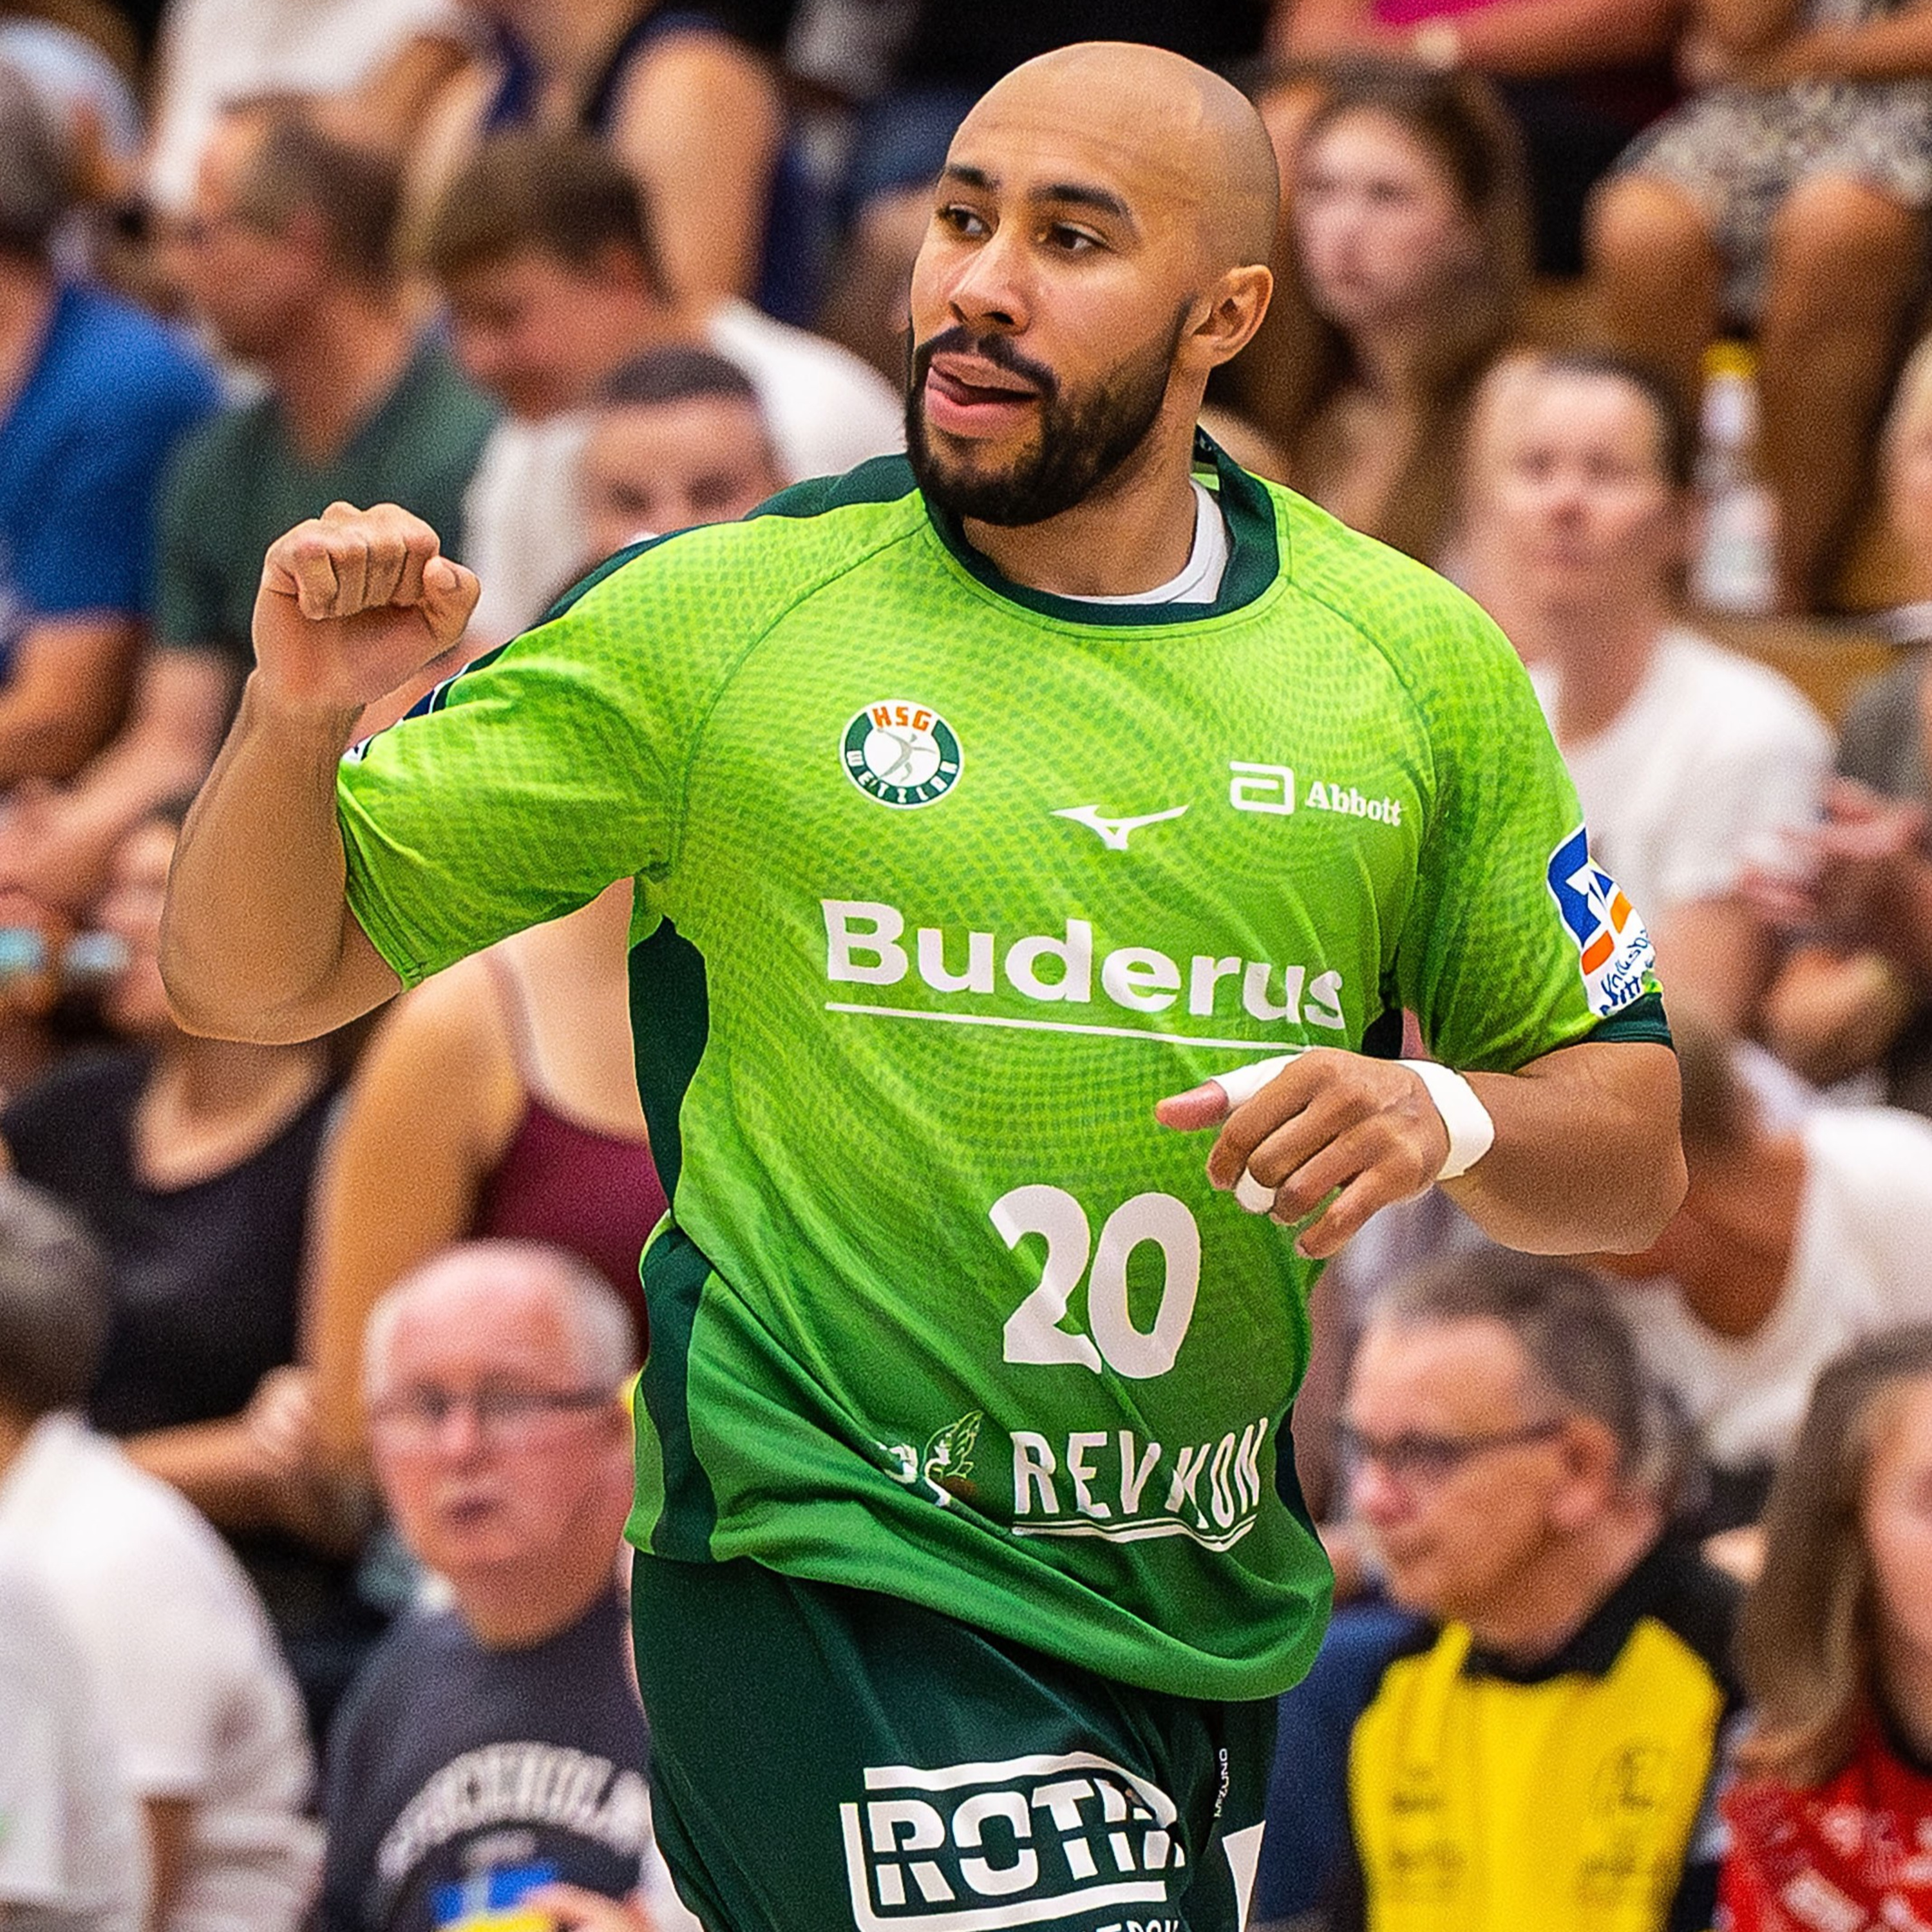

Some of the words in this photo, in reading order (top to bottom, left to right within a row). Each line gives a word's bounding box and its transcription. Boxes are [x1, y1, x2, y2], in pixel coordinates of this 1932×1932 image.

[872, 706, 932, 732] HSG
[1305, 781, 1401, 827] Abbott
[820, 899, 1346, 1030] Buderus
[988, 1184, 1202, 1379] 20
[867, 1777, 1171, 1906] ROTH
